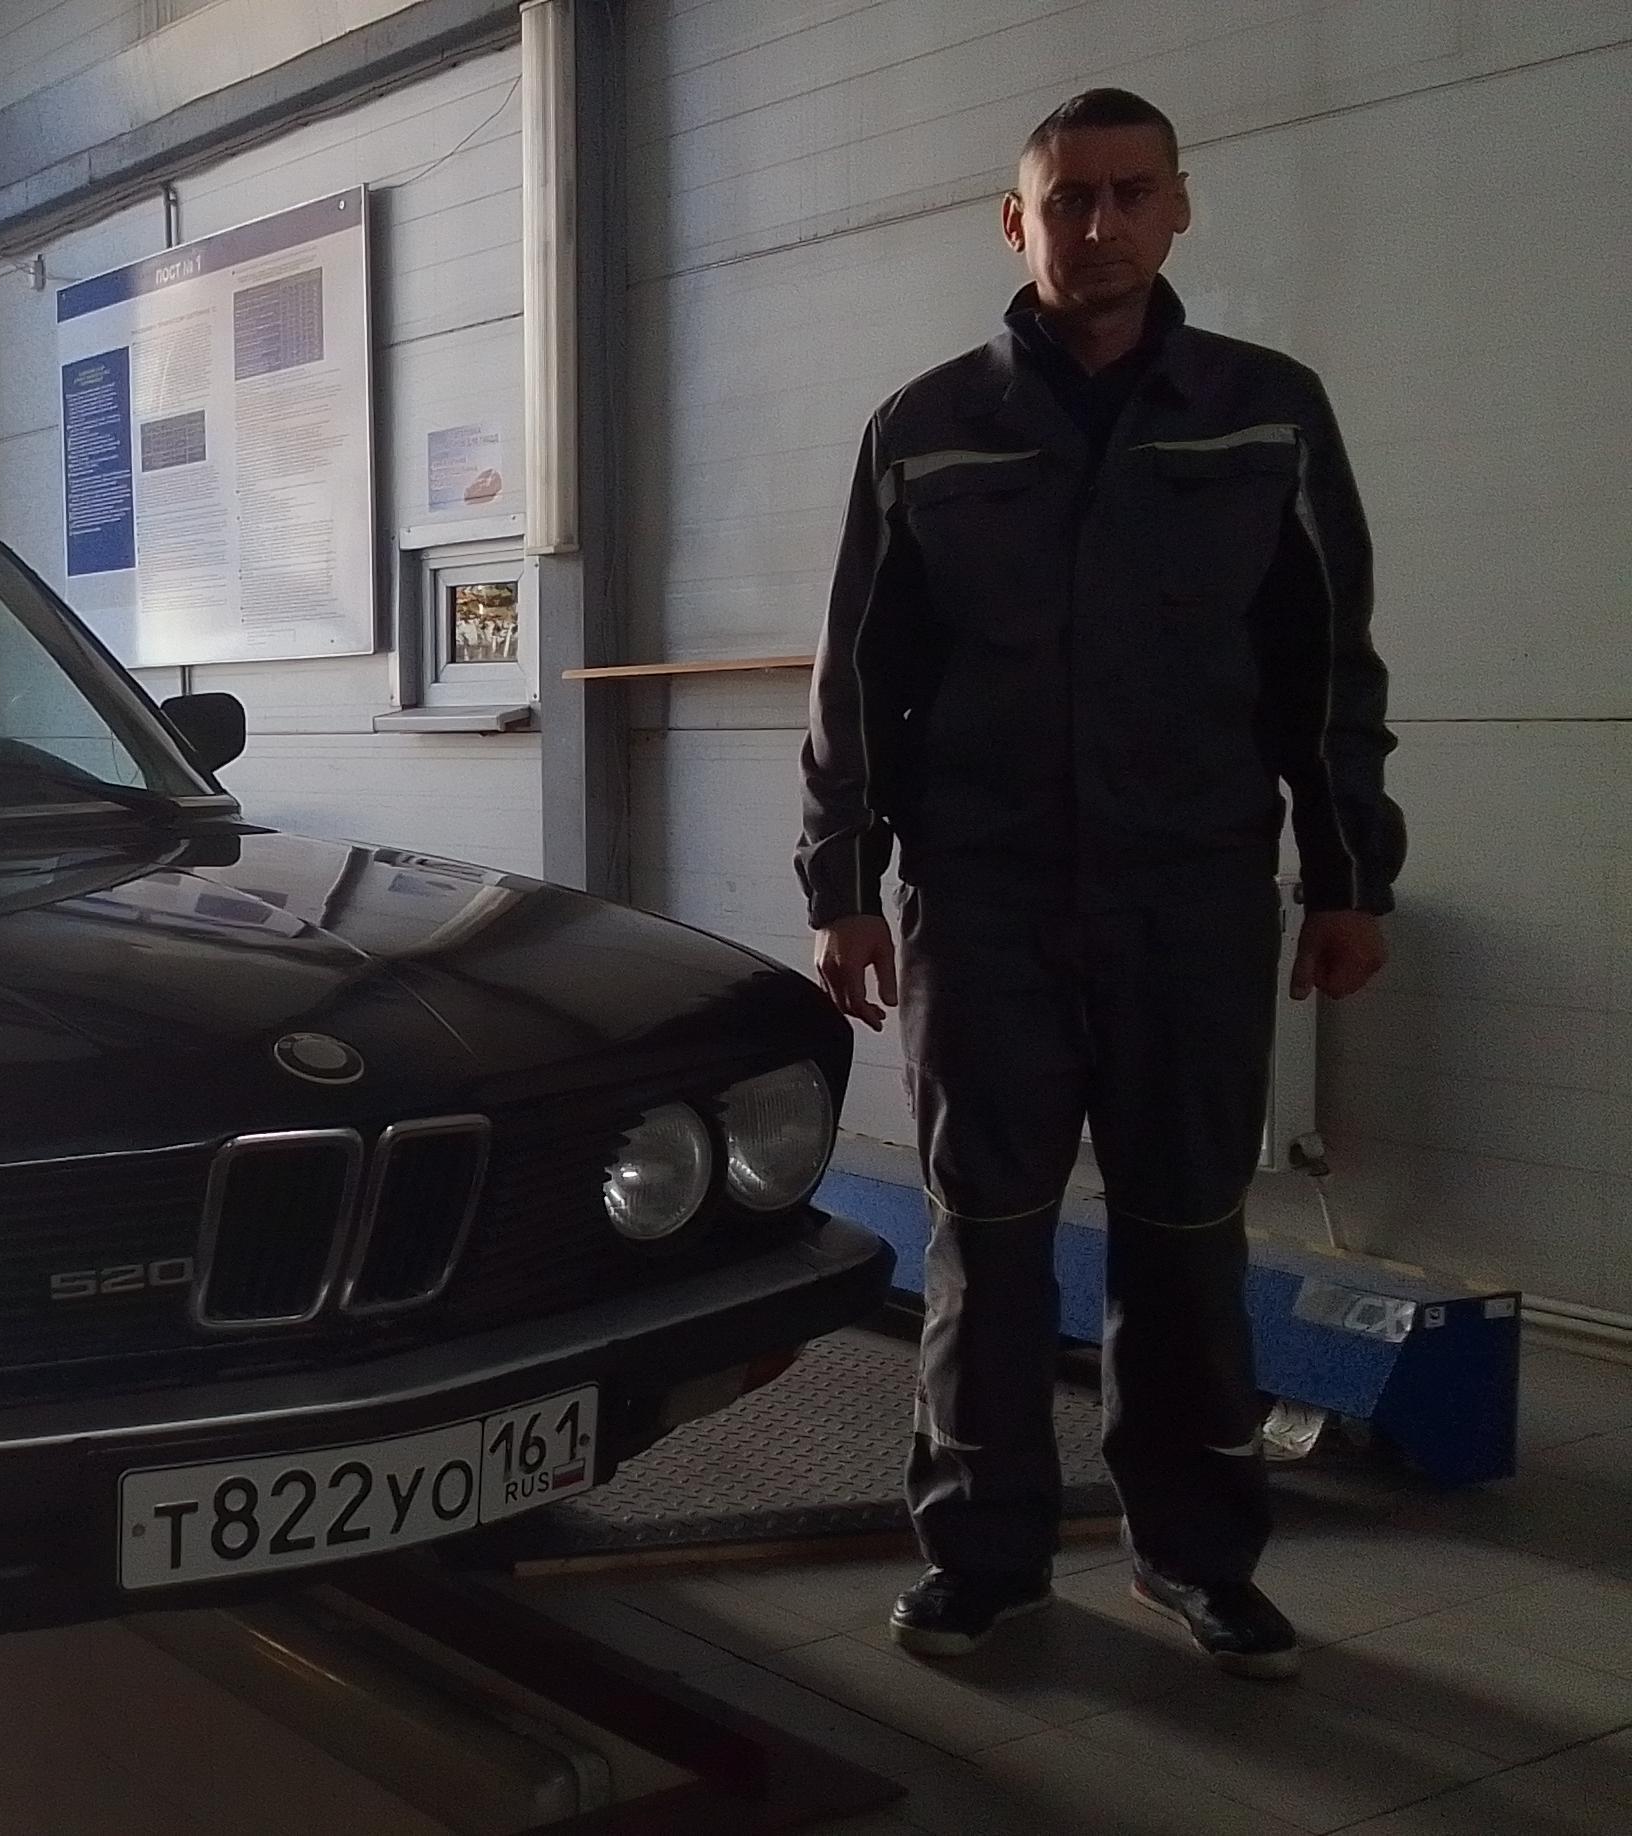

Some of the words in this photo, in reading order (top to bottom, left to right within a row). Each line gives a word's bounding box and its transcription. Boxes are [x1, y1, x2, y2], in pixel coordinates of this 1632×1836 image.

[50, 1257, 194, 1301] 520
[488, 1401, 581, 1477] 161
[504, 1470, 550, 1505] RUS
